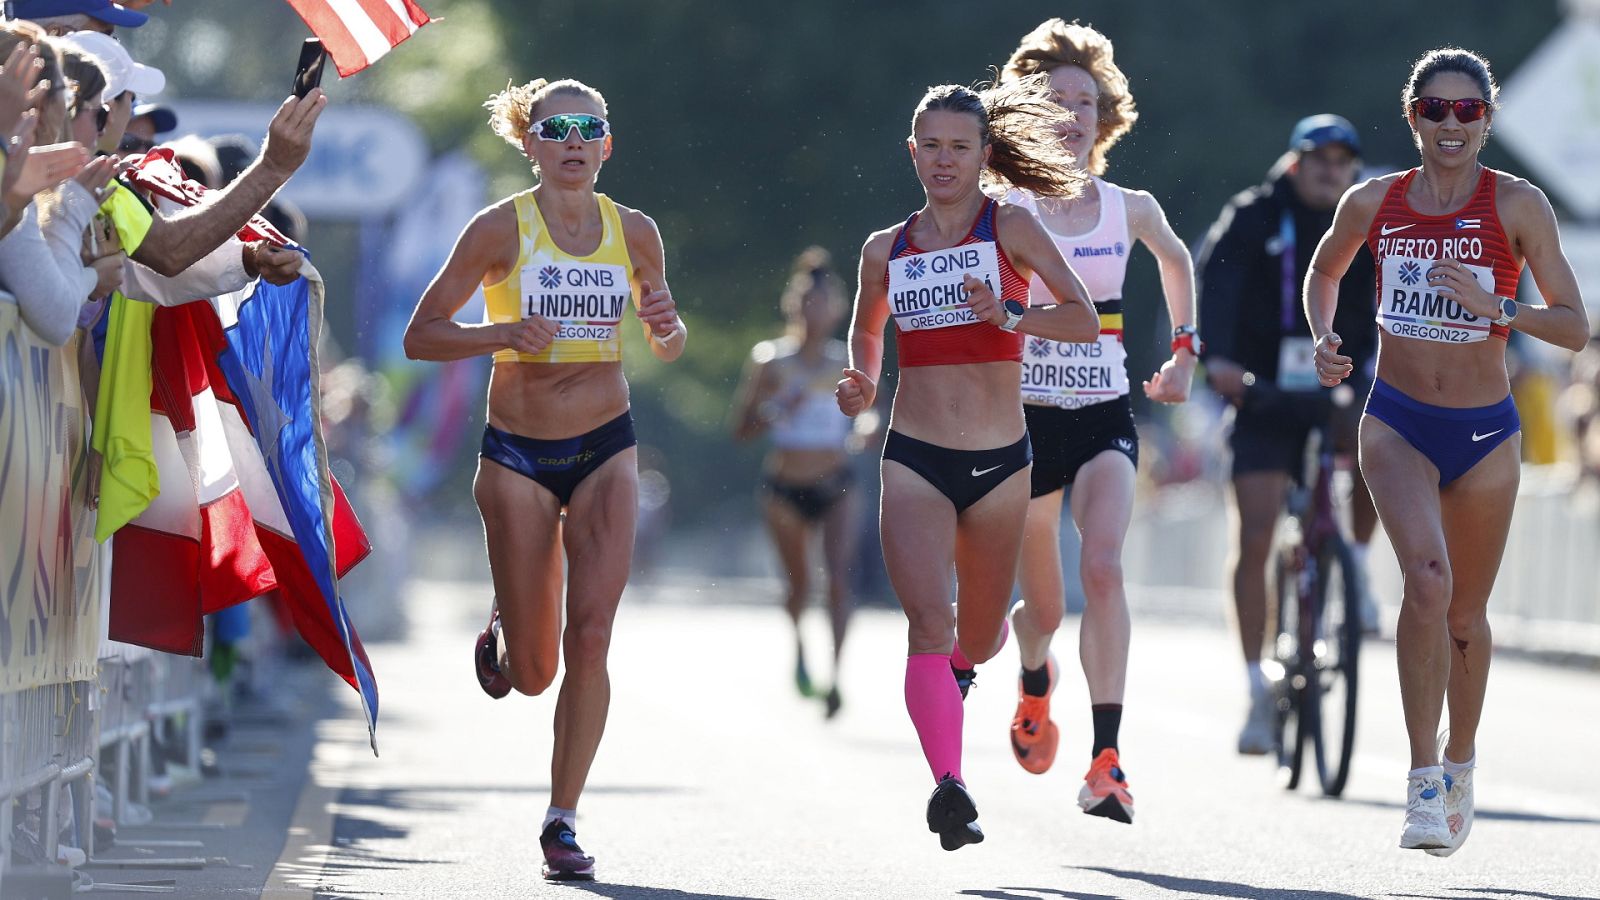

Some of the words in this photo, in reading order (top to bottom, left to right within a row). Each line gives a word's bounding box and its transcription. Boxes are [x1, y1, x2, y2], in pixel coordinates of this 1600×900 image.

[1073, 246, 1113, 258] Allianz
[1377, 238, 1438, 260] PUERTO
[1442, 237, 1483, 260] RICO
[931, 250, 980, 274] QNB
[567, 268, 614, 287] QNB
[894, 274, 996, 312] HROCHOÁ
[528, 294, 624, 318] LINDHOLM
[911, 310, 979, 328] OREGON2
[1392, 322, 1470, 342] OREGON22
[1056, 341, 1103, 358] QNB
[1021, 363, 1112, 388] GORISSEN
[538, 453, 584, 466] CRAFT
